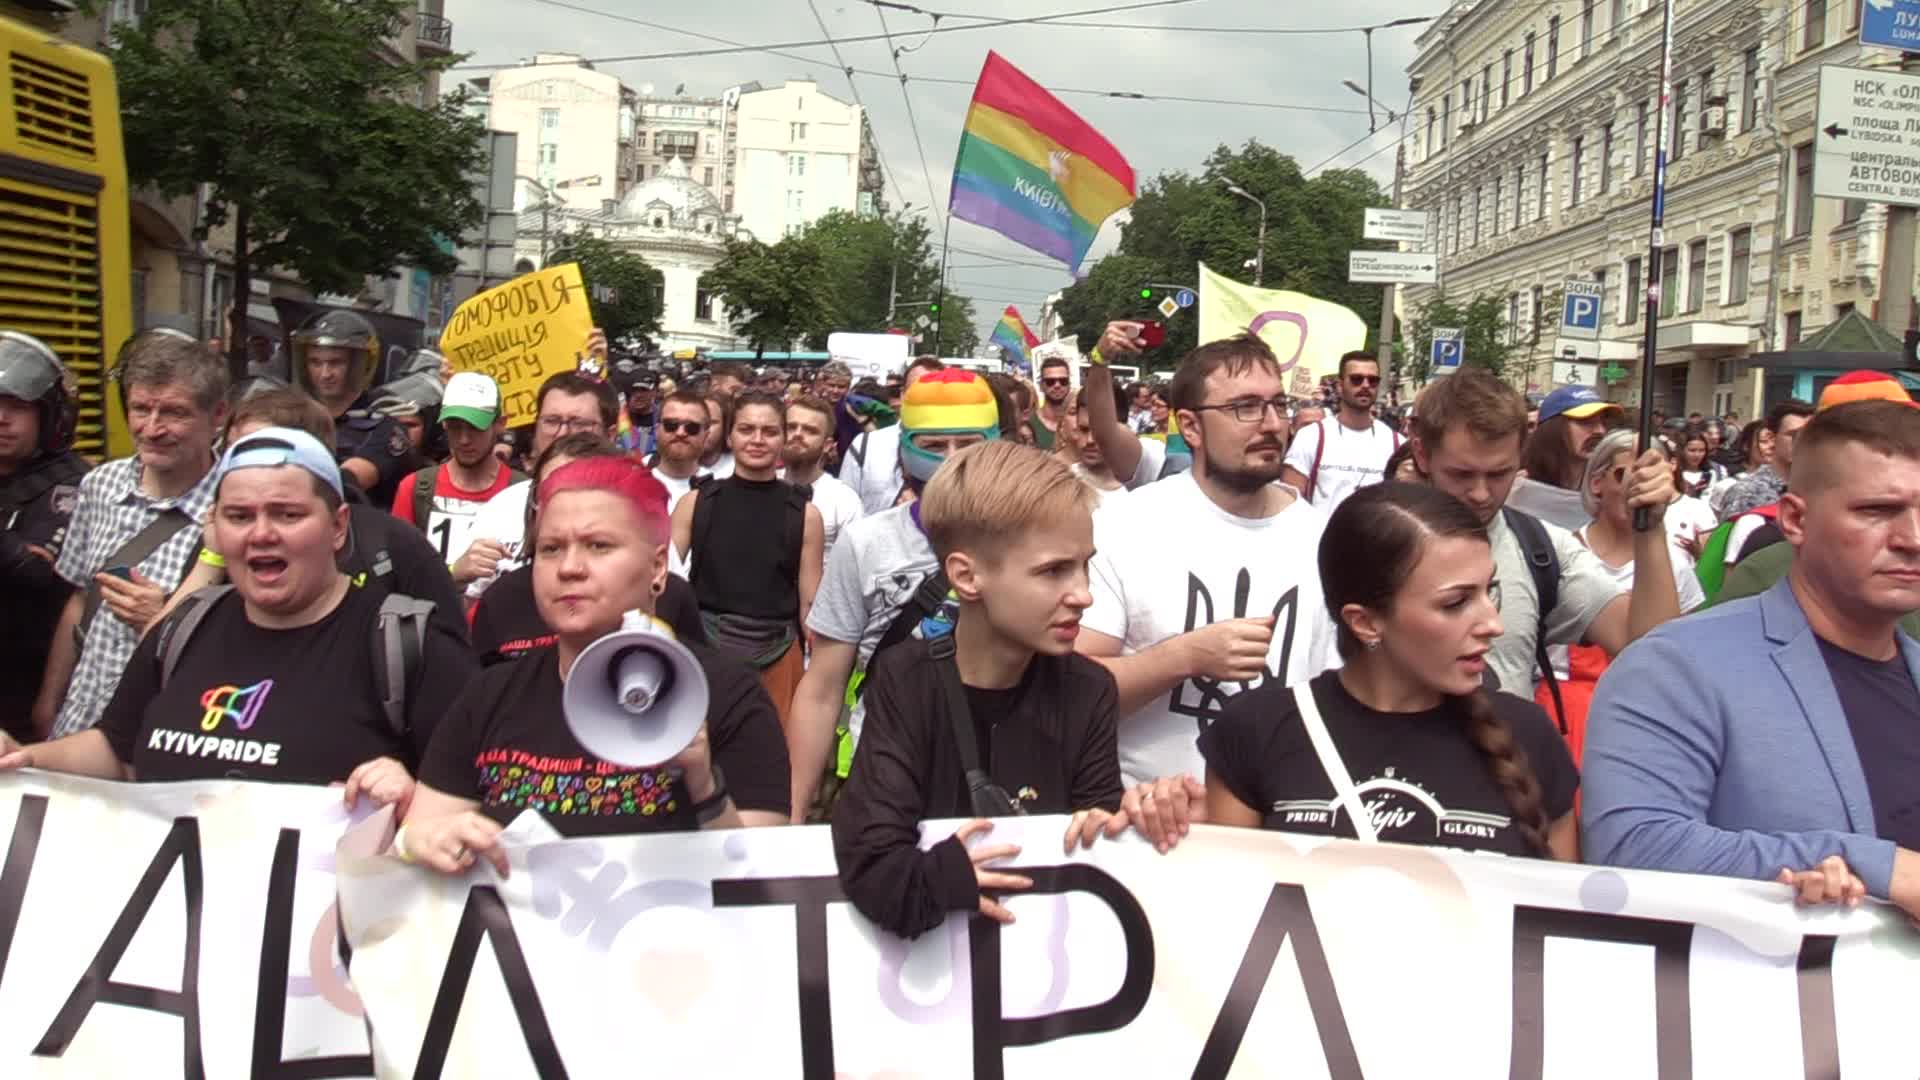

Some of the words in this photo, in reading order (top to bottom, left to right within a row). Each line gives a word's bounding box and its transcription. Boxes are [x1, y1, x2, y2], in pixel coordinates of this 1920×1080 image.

[1894, 11, 1920, 27] ЛУ
[1854, 80, 1886, 96] НСК
[1853, 116, 1899, 130] площа
[1851, 151, 1920, 168] централь
[1567, 282, 1601, 296] ЗОНА
[148, 728, 283, 766] KYIVPRIDE
[1285, 810, 1329, 824] PRIDE
[1362, 799, 1417, 834] Kyiv
[1444, 821, 1497, 839] GLORY
